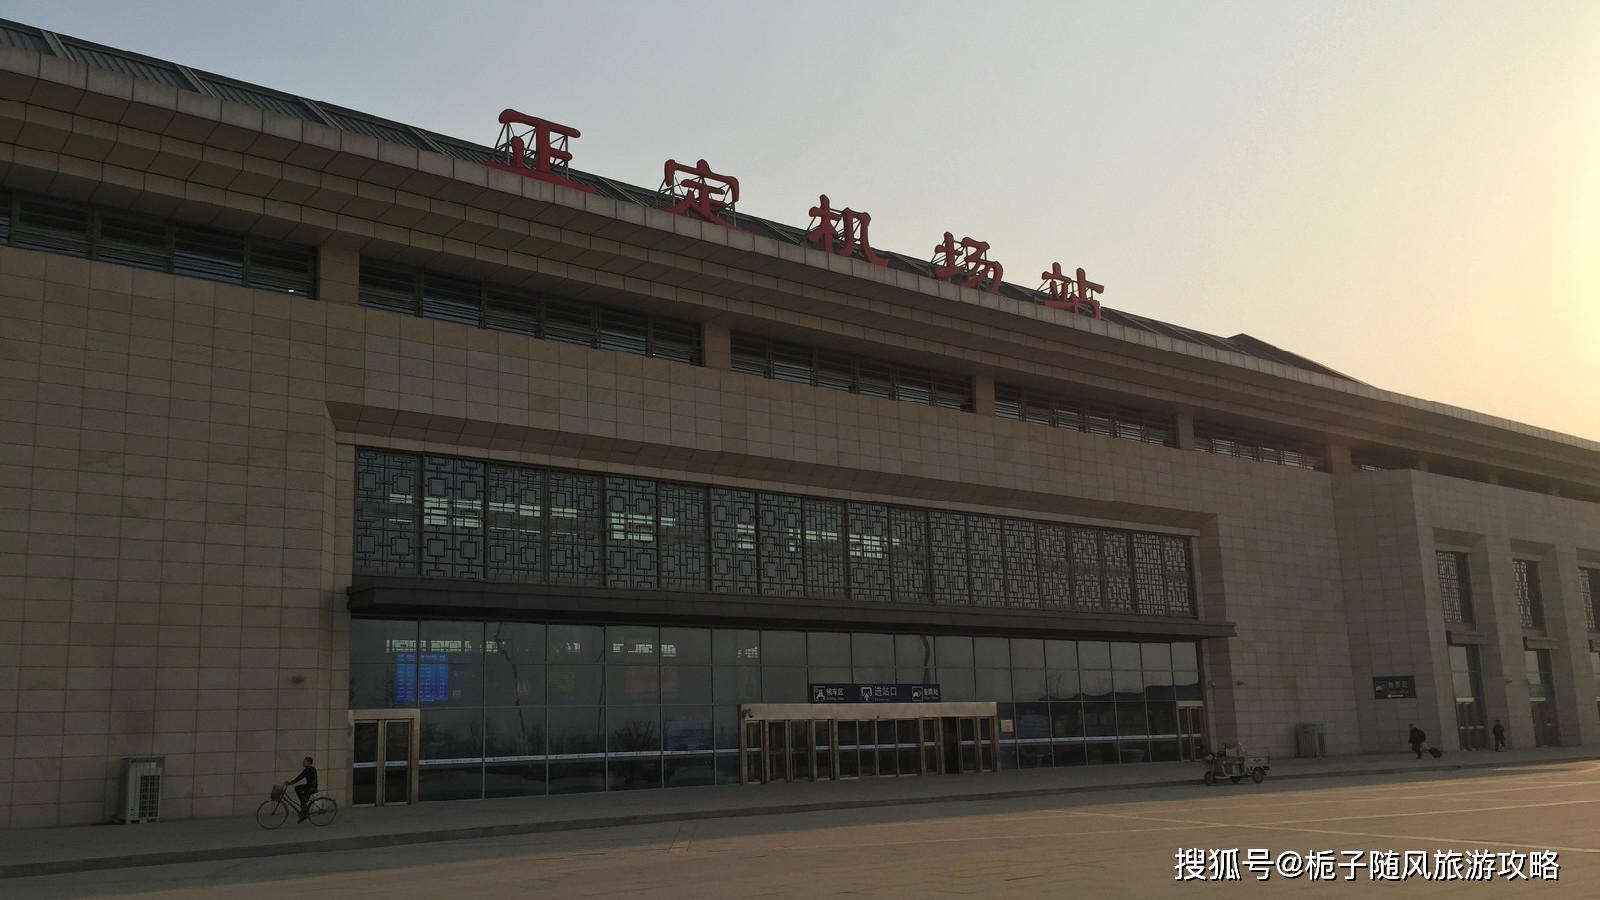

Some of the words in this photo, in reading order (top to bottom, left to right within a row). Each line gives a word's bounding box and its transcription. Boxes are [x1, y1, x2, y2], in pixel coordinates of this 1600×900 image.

[486, 108, 1105, 320] 正定机场站
[874, 686, 897, 697] 进站口
